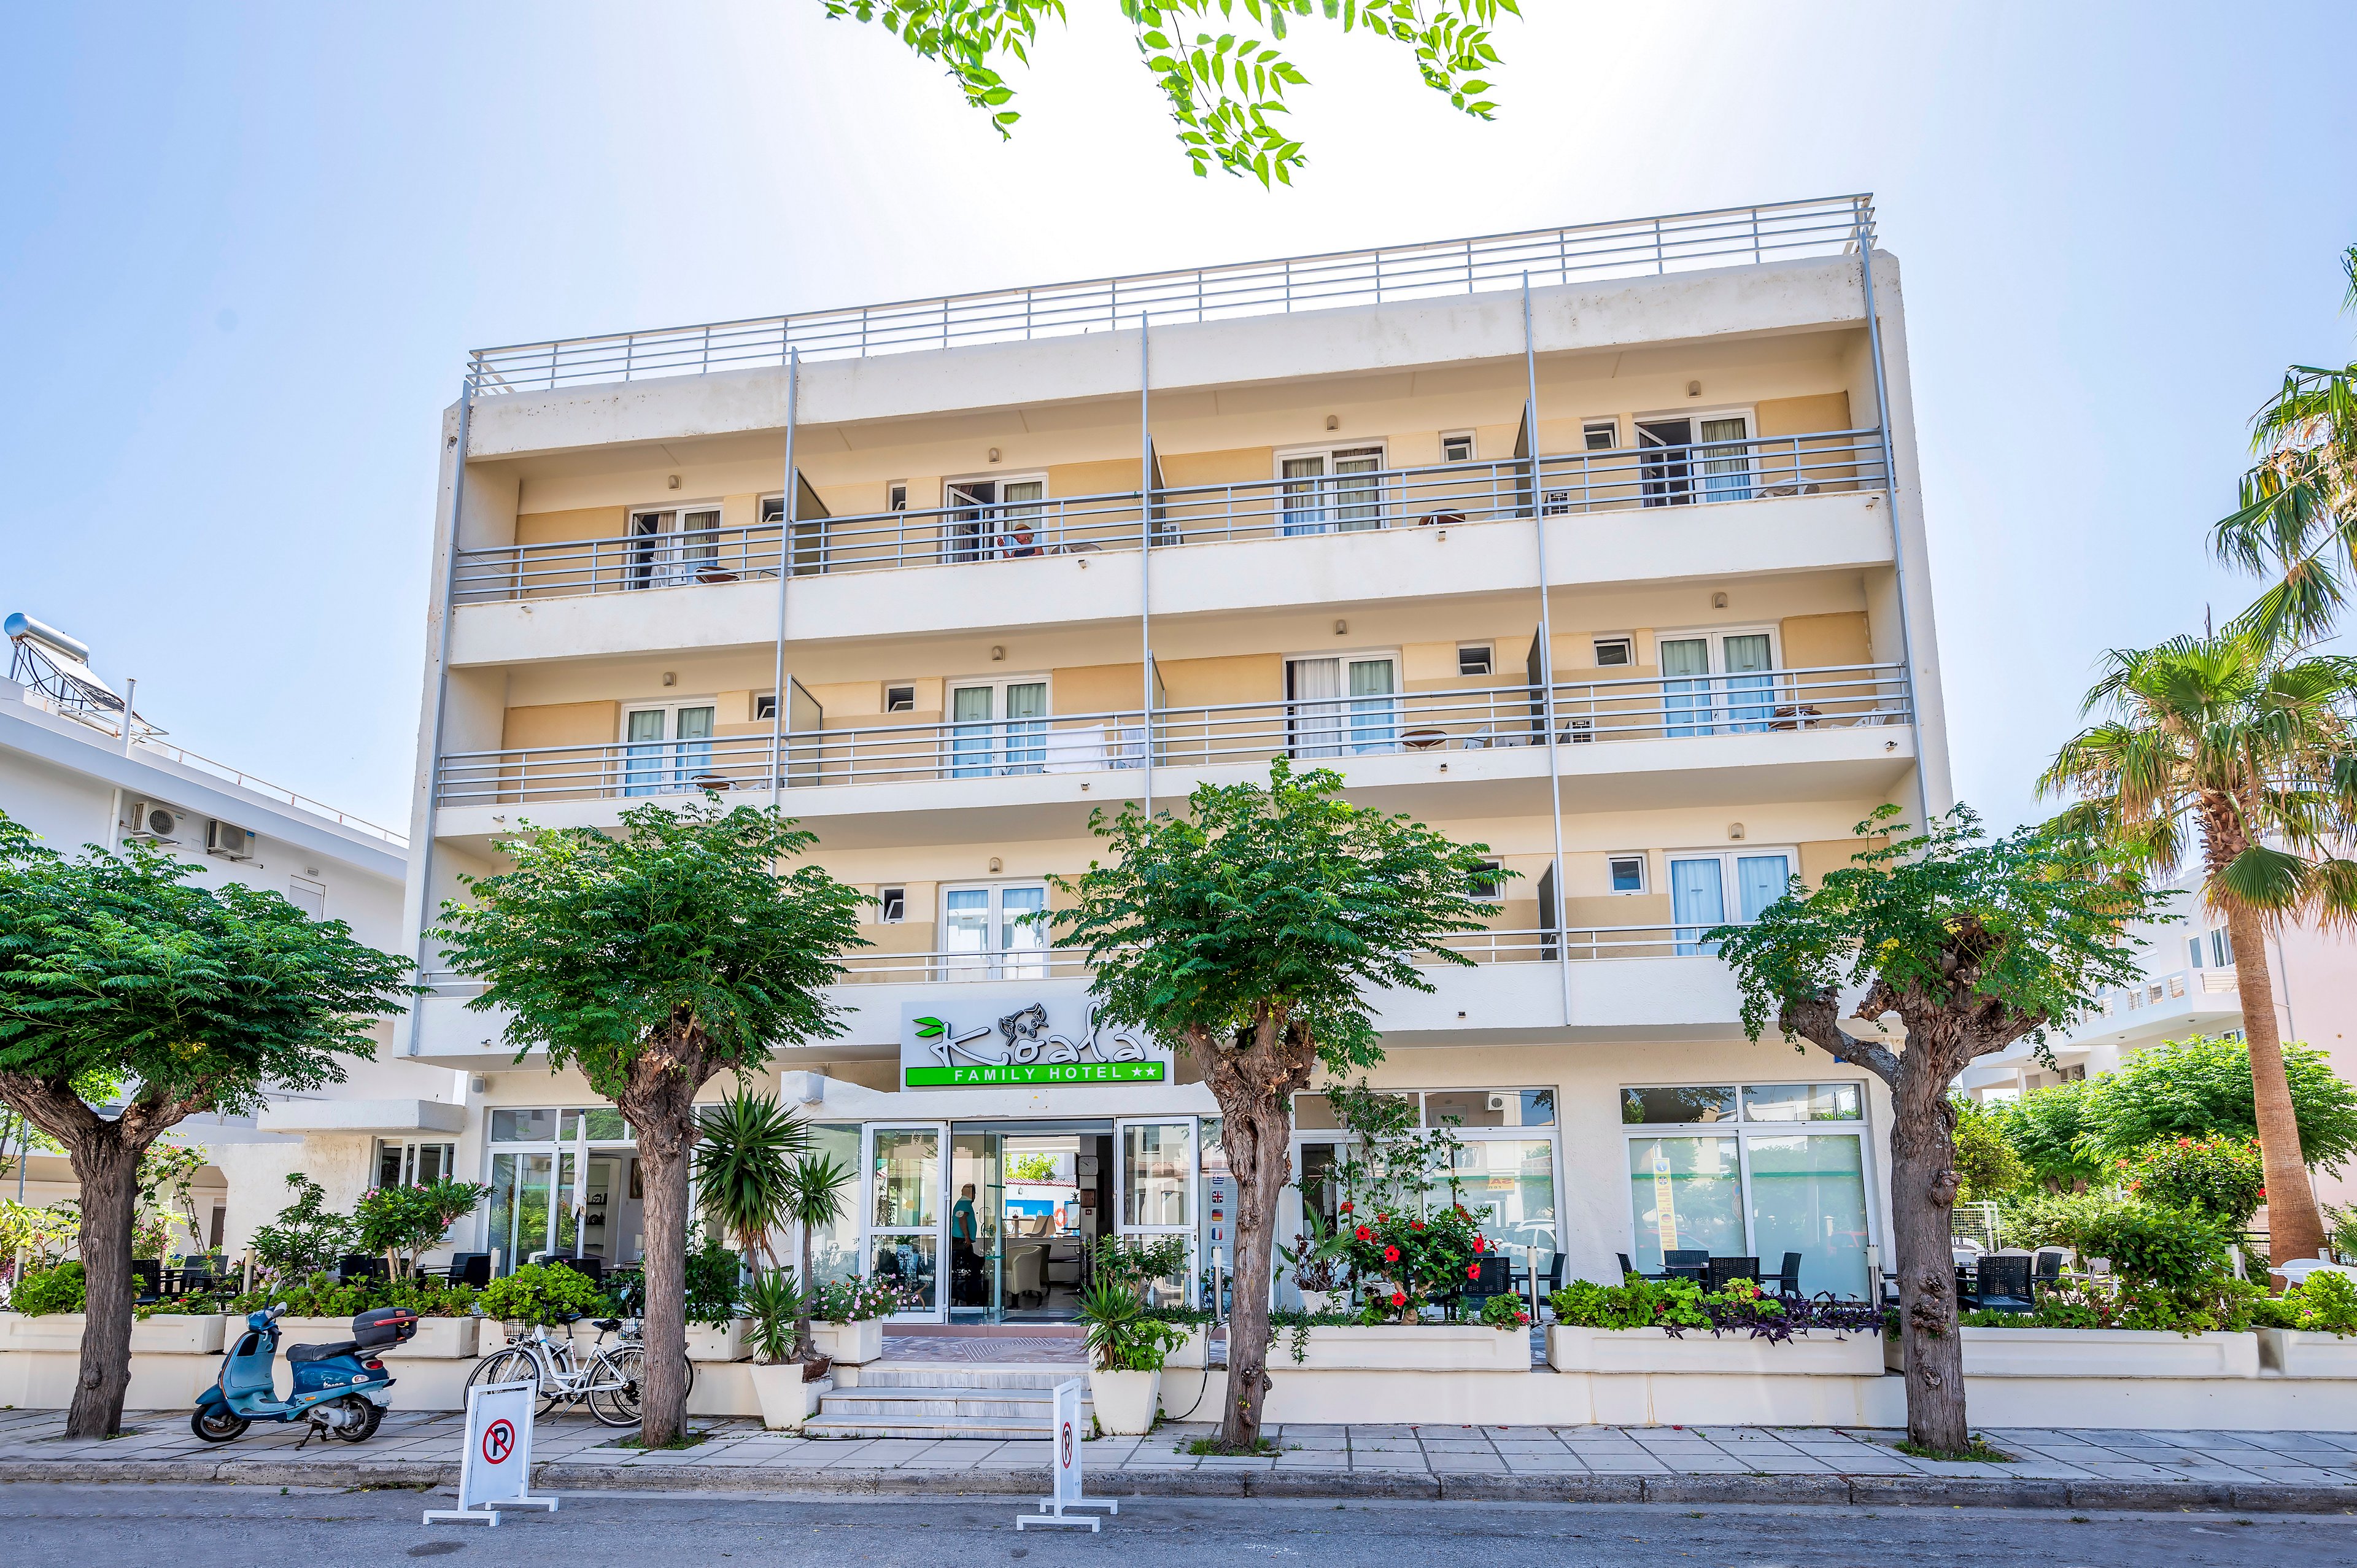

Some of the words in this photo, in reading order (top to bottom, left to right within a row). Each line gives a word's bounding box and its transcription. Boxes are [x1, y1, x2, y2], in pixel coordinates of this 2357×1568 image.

[929, 1002, 1145, 1068] Koala
[954, 1068, 1036, 1082] FAMILY
[1049, 1066, 1122, 1079] HOTEL
